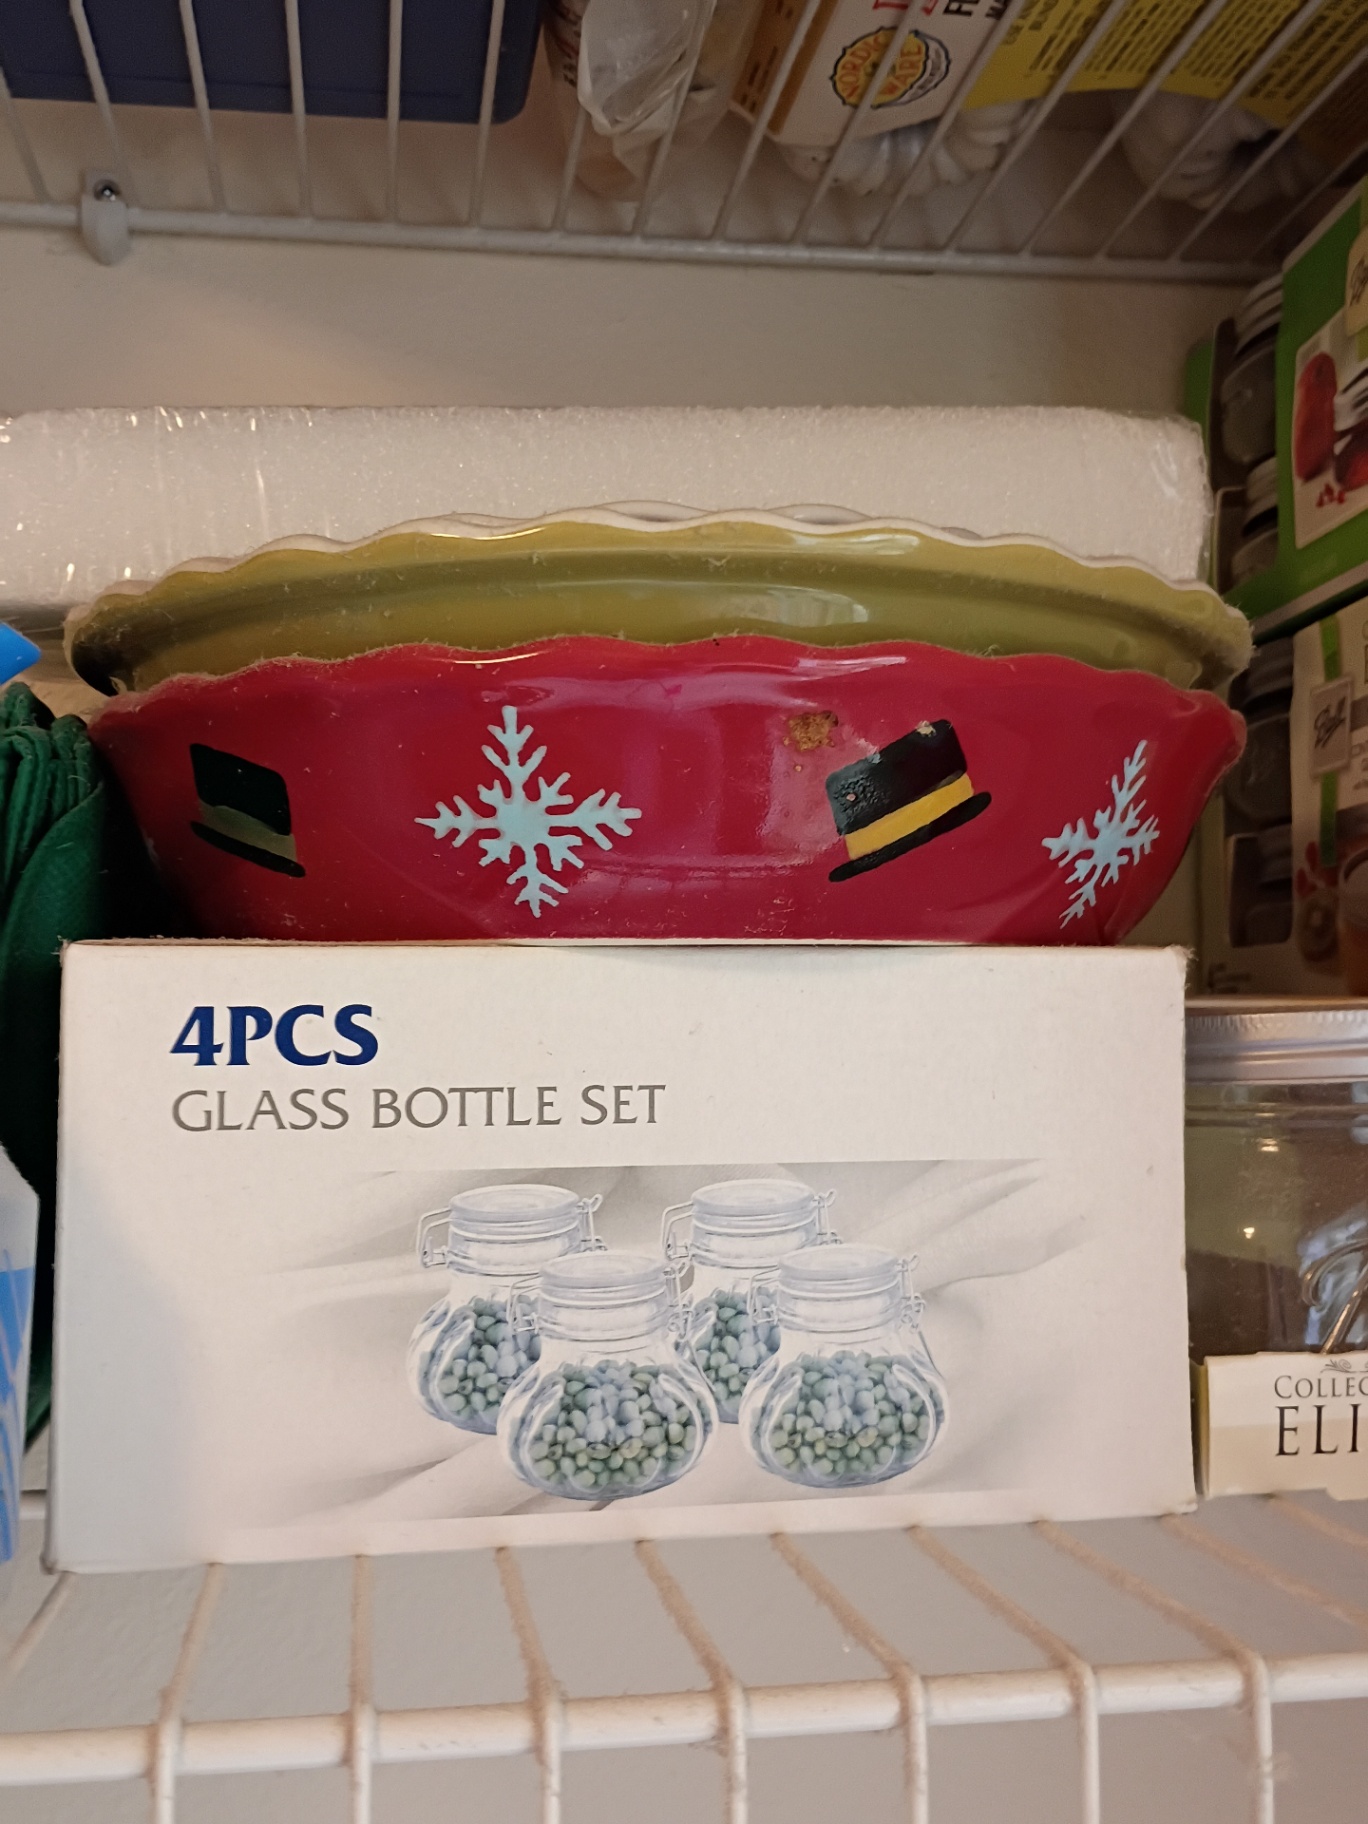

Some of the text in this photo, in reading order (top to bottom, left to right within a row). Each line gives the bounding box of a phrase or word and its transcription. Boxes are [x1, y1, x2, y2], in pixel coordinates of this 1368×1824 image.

[169, 1004, 379, 1067] 4PCS
[172, 1084, 667, 1133] GLASS BOTTLE SET
[1275, 1404, 1362, 1457] ELI
